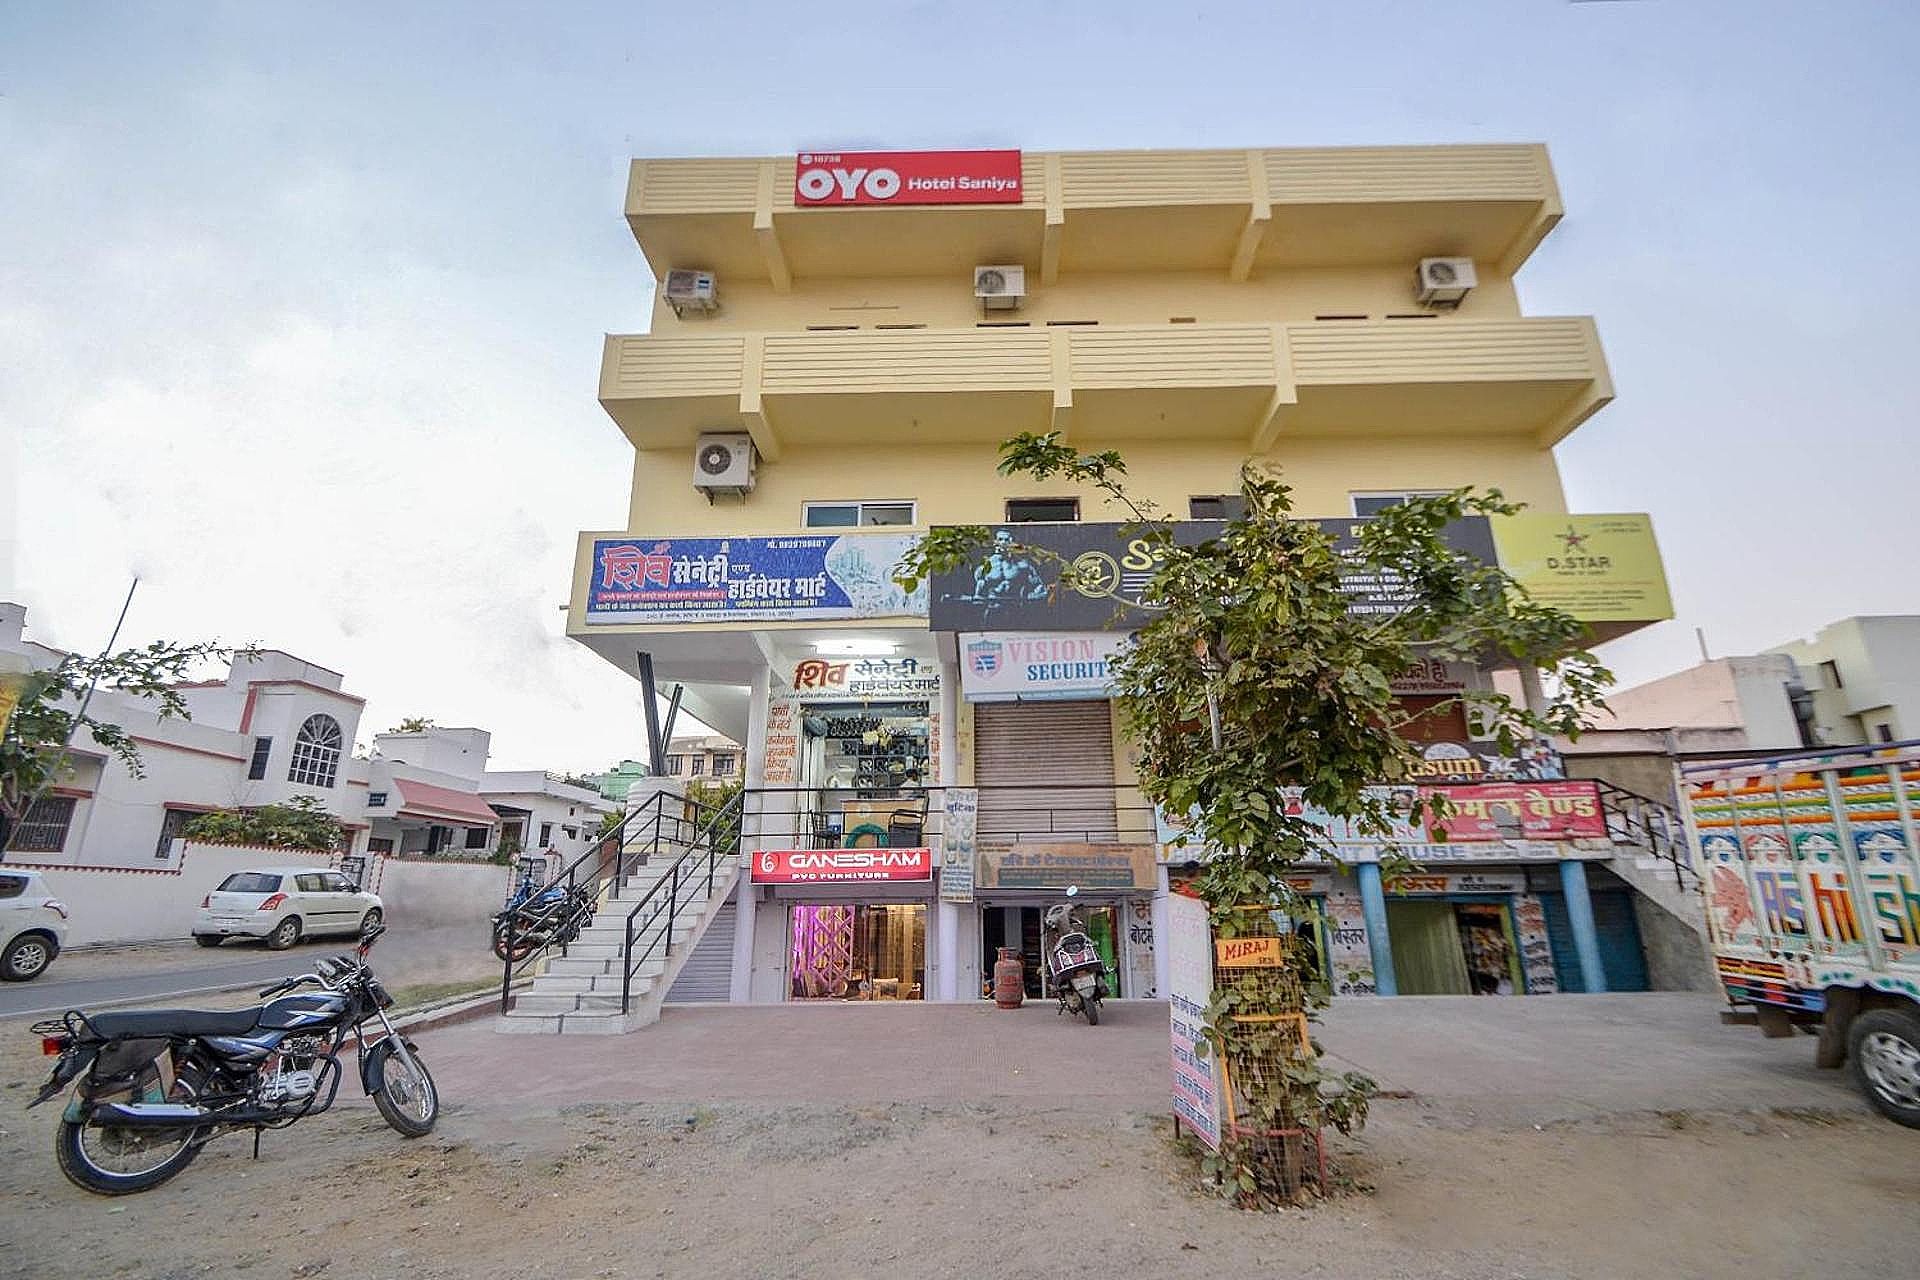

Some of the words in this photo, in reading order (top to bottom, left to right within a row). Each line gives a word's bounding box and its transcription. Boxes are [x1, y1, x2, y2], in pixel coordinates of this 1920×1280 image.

[798, 168, 900, 200] OYO
[909, 176, 954, 190] Hotel
[958, 176, 1016, 191] Saniya
[1008, 639, 1095, 663] VISION
[794, 660, 849, 690] शिव
[1400, 757, 1483, 776] usum
[1524, 788, 1598, 817] बैण्ड
[788, 853, 921, 868] GANESHAM
[820, 872, 890, 880] FURNITURE
[1225, 940, 1269, 961] MIRAJ
